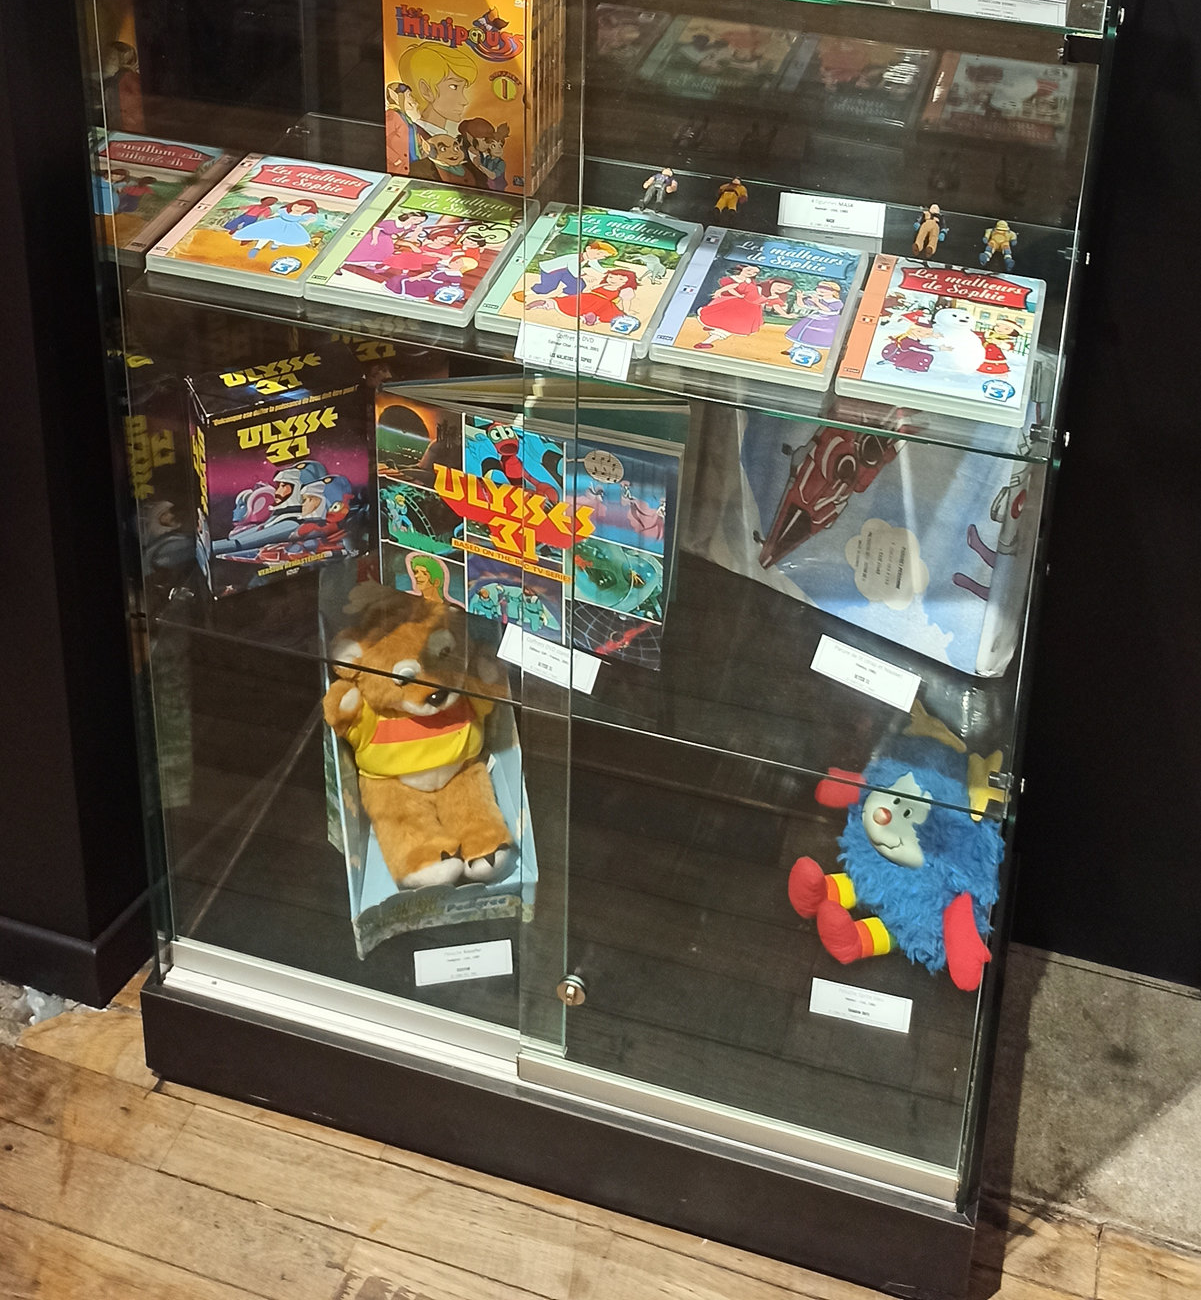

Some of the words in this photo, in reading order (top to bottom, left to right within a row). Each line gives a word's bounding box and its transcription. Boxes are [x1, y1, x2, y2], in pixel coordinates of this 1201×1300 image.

[395, 3, 423, 18] Les
[396, 14, 524, 62] Minipouss
[264, 164, 293, 177] Les
[296, 169, 363, 189] malheurs
[271, 174, 289, 185] de
[291, 176, 345, 194] Sophie
[416, 189, 441, 201] Les
[448, 195, 514, 213] malheurs
[421, 200, 439, 210] de
[442, 202, 494, 220] Sophie
[573, 213, 602, 226] Les
[605, 218, 678, 238] malheurs
[582, 224, 601, 235] de
[605, 226, 659, 245] Sophie
[737, 240, 765, 252] Les
[769, 246, 844, 266] malheurs
[746, 251, 766, 262] de
[770, 255, 827, 273] Sophie
[908, 268, 940, 281] Les
[944, 274, 1024, 296] malheurs
[921, 280, 943, 291] de
[946, 283, 1006, 302] Sophie
[218, 352, 322, 388] ULYSSE
[254, 373, 304, 395] 31
[237, 406, 339, 450] ULYSSE
[265, 435, 311, 464] 31
[433, 463, 596, 538] ULYSSES
[453, 539, 481, 554] BASED
[482, 548, 495, 557] ON
[495, 551, 514, 561] THE
[488, 516, 540, 564] 31
